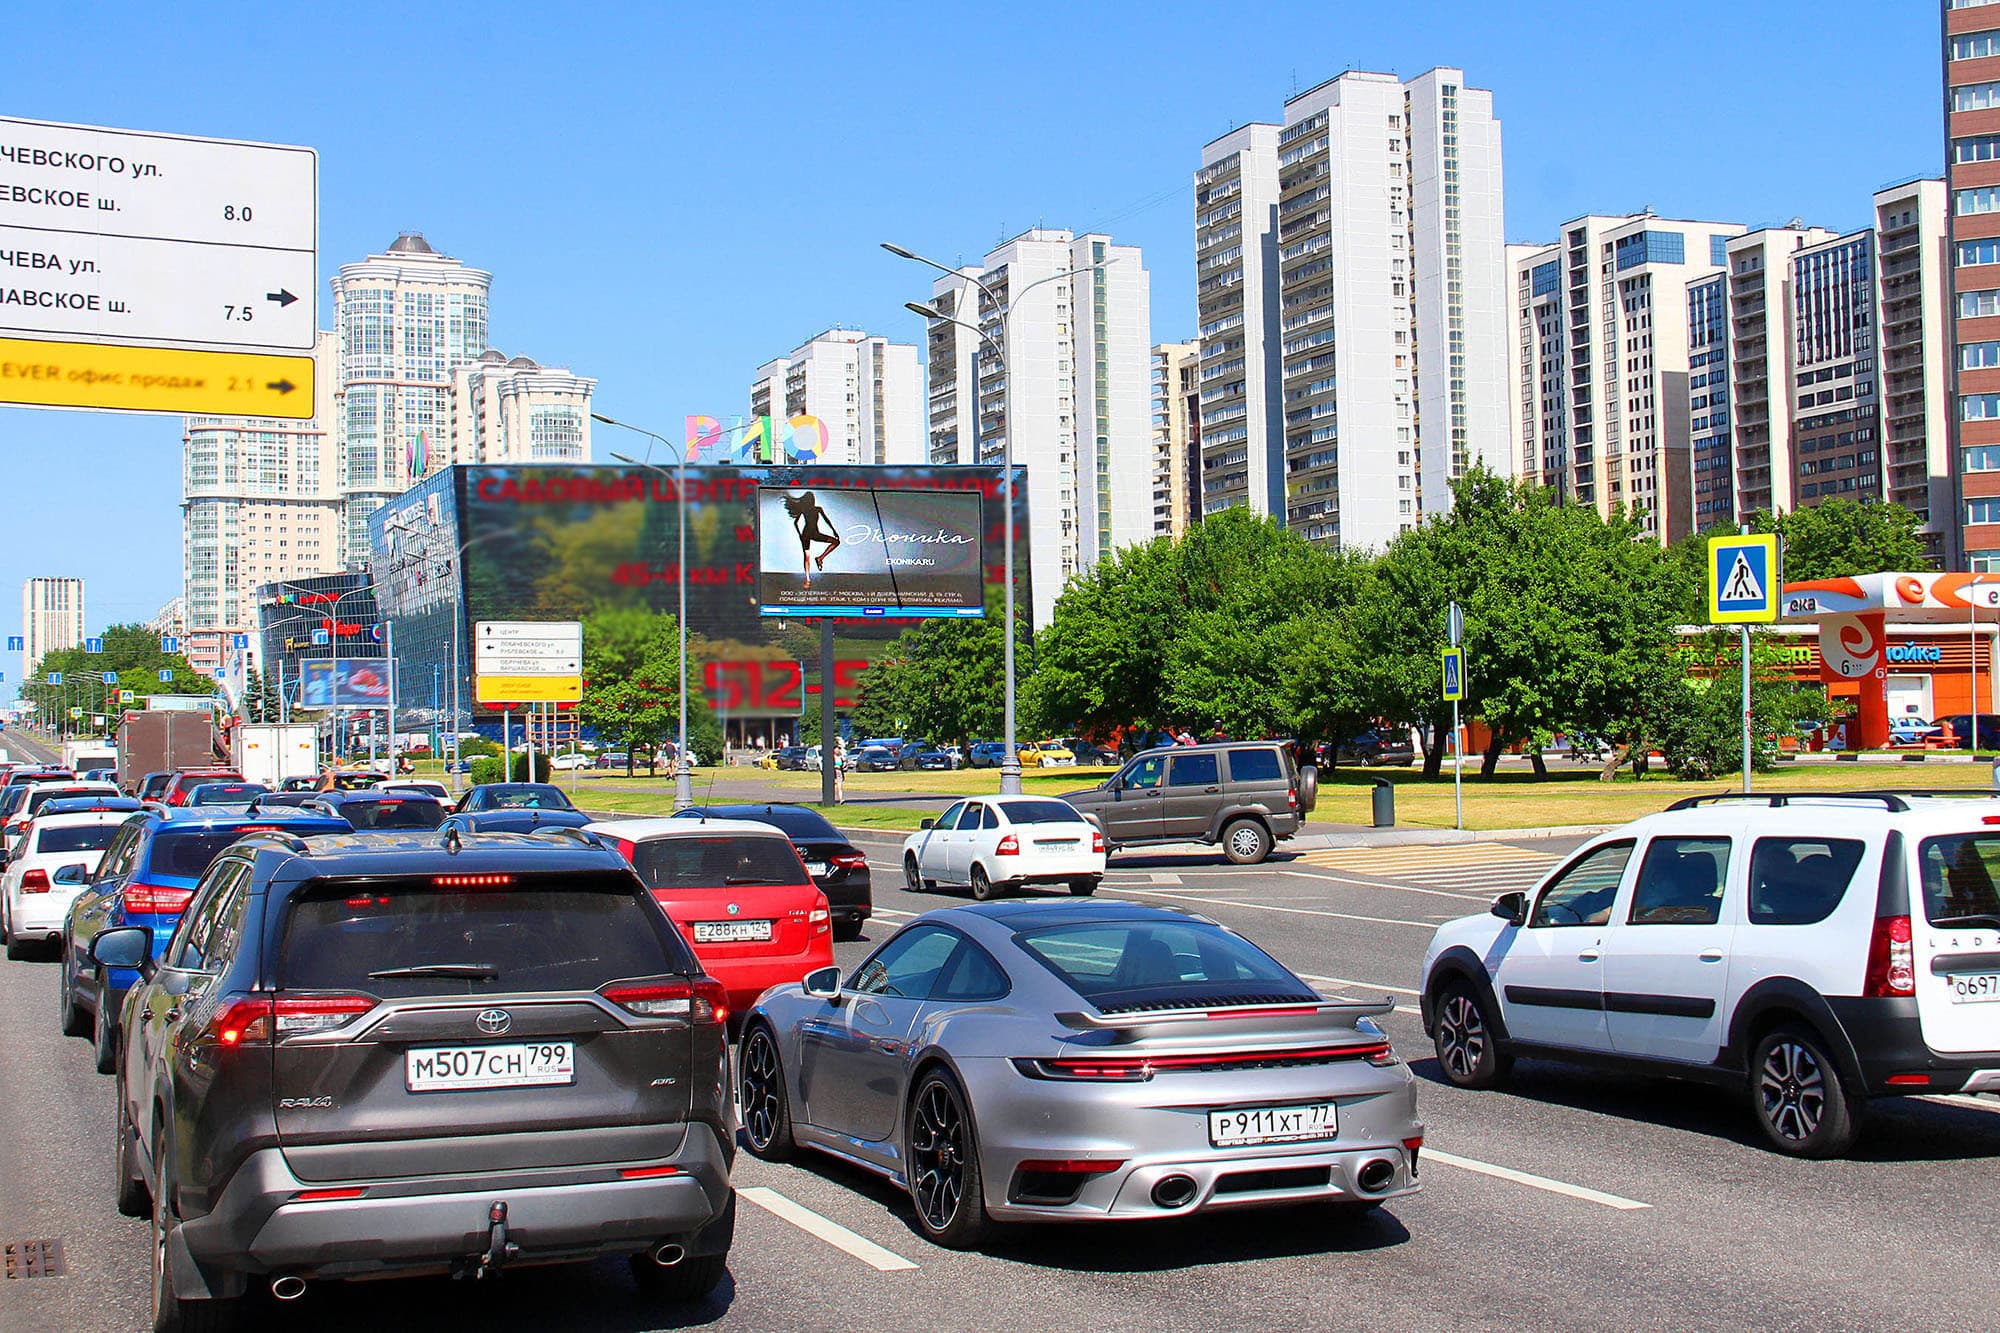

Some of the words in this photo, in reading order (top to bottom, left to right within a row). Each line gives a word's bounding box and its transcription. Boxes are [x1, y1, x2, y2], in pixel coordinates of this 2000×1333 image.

[132, 161, 163, 179] ул.
[98, 198, 121, 212] ш.
[224, 205, 252, 222] 8.0
[69, 257, 102, 275] ул.
[0, 287, 100, 311] АВСКОЕ
[108, 299, 132, 314] ш.
[224, 304, 253, 322] 7.5
[68, 369, 122, 386] офис
[130, 373, 206, 390] продаж
[685, 415, 829, 461] РИО
[477, 475, 646, 503] САДОВЫЙ
[845, 524, 974, 545] Эконика
[885, 558, 935, 566] EKONIKA.RU
[1841, 659, 1850, 675] 6
[699, 924, 747, 936] Е288КН
[416, 1049, 521, 1078] М507СН
[527, 1045, 566, 1065] 799
[537, 1065, 557, 1073] RUS
[1220, 1110, 1302, 1136] Р911ХТ
[1310, 1105, 1329, 1123] 77
